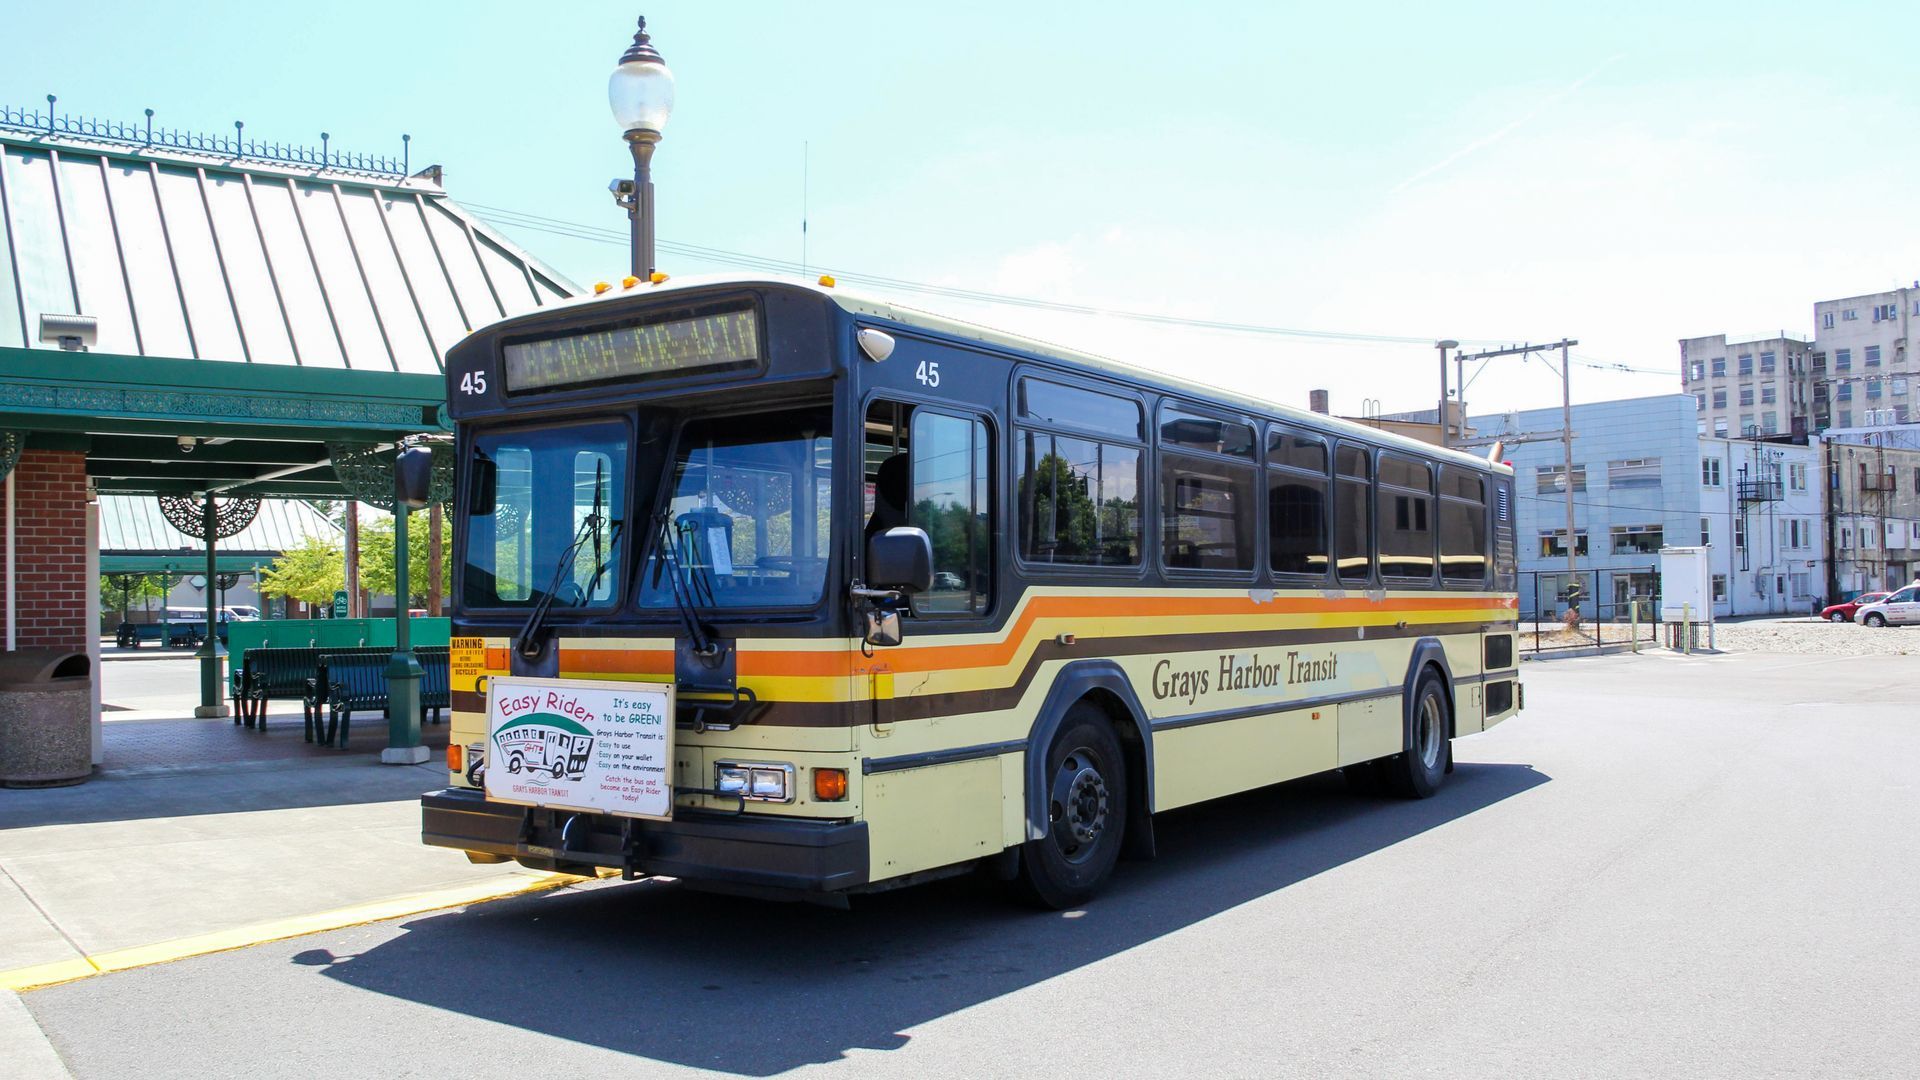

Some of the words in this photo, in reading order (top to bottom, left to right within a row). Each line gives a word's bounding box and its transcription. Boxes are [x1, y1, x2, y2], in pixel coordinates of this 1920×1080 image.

[916, 361, 940, 388] 45
[460, 370, 487, 395] 45
[452, 639, 482, 649] WARNING
[1152, 659, 1209, 706] Grays
[1217, 654, 1281, 692] Harbor
[1287, 650, 1338, 685] Transit
[499, 695, 540, 717] Easy
[546, 691, 595, 723] Rider
[613, 698, 629, 709] It's
[632, 702, 652, 712] easy
[603, 713, 612, 722] to
[615, 713, 626, 723] be
[628, 713, 662, 725] GREEN!
[596, 729, 613, 738] Grays
[614, 730, 634, 738] Harbor
[636, 731, 656, 740] Transit
[635, 754, 653, 762] wallet
[605, 775, 622, 783] Catch
[623, 776, 633, 784] the
[512, 784, 528, 793] GRAYS
[528, 786, 547, 796] HARBOR
[548, 787, 569, 798] TRANSIT
[630, 785, 644, 794] Easy
[645, 787, 661, 795] Rider
[621, 794, 639, 803] today!
